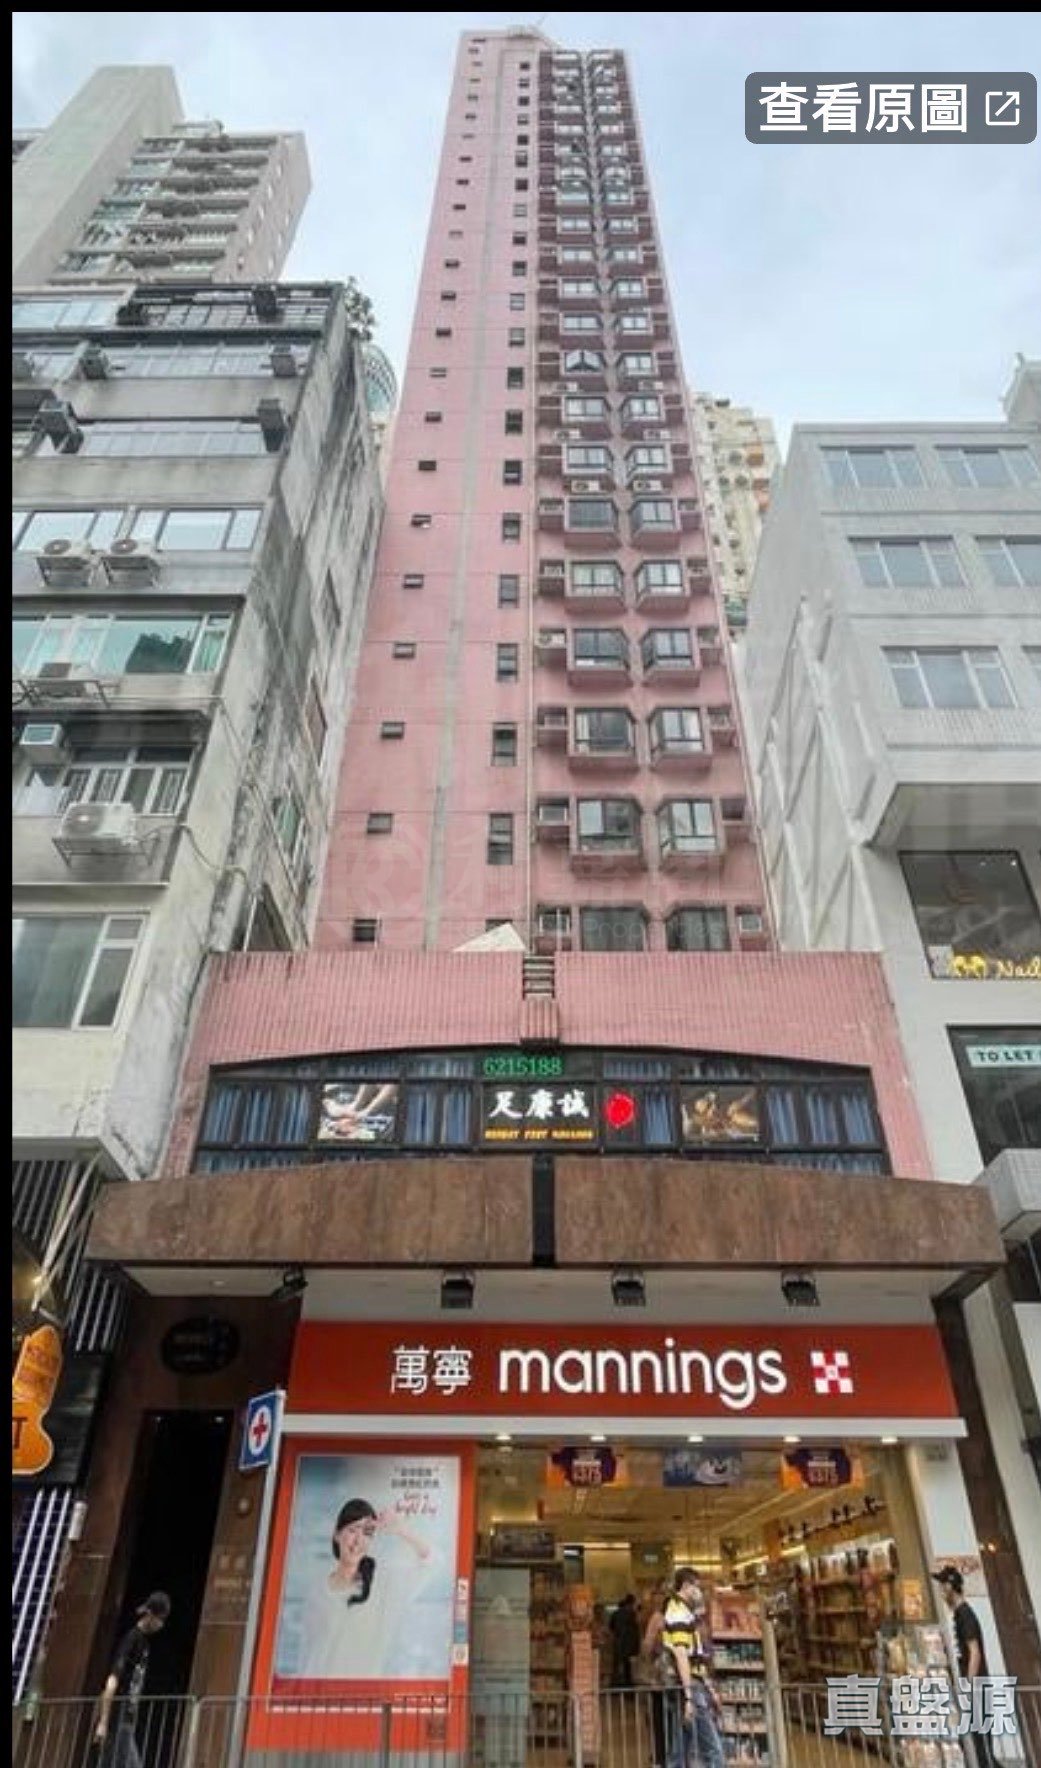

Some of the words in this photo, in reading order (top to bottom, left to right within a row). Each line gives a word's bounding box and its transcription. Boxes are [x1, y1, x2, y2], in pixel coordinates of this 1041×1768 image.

[977, 1050, 999, 1062] TO
[1003, 1048, 1033, 1061] LET
[390, 1345, 474, 1395] 萬寧
[499, 1337, 787, 1410] mannings
